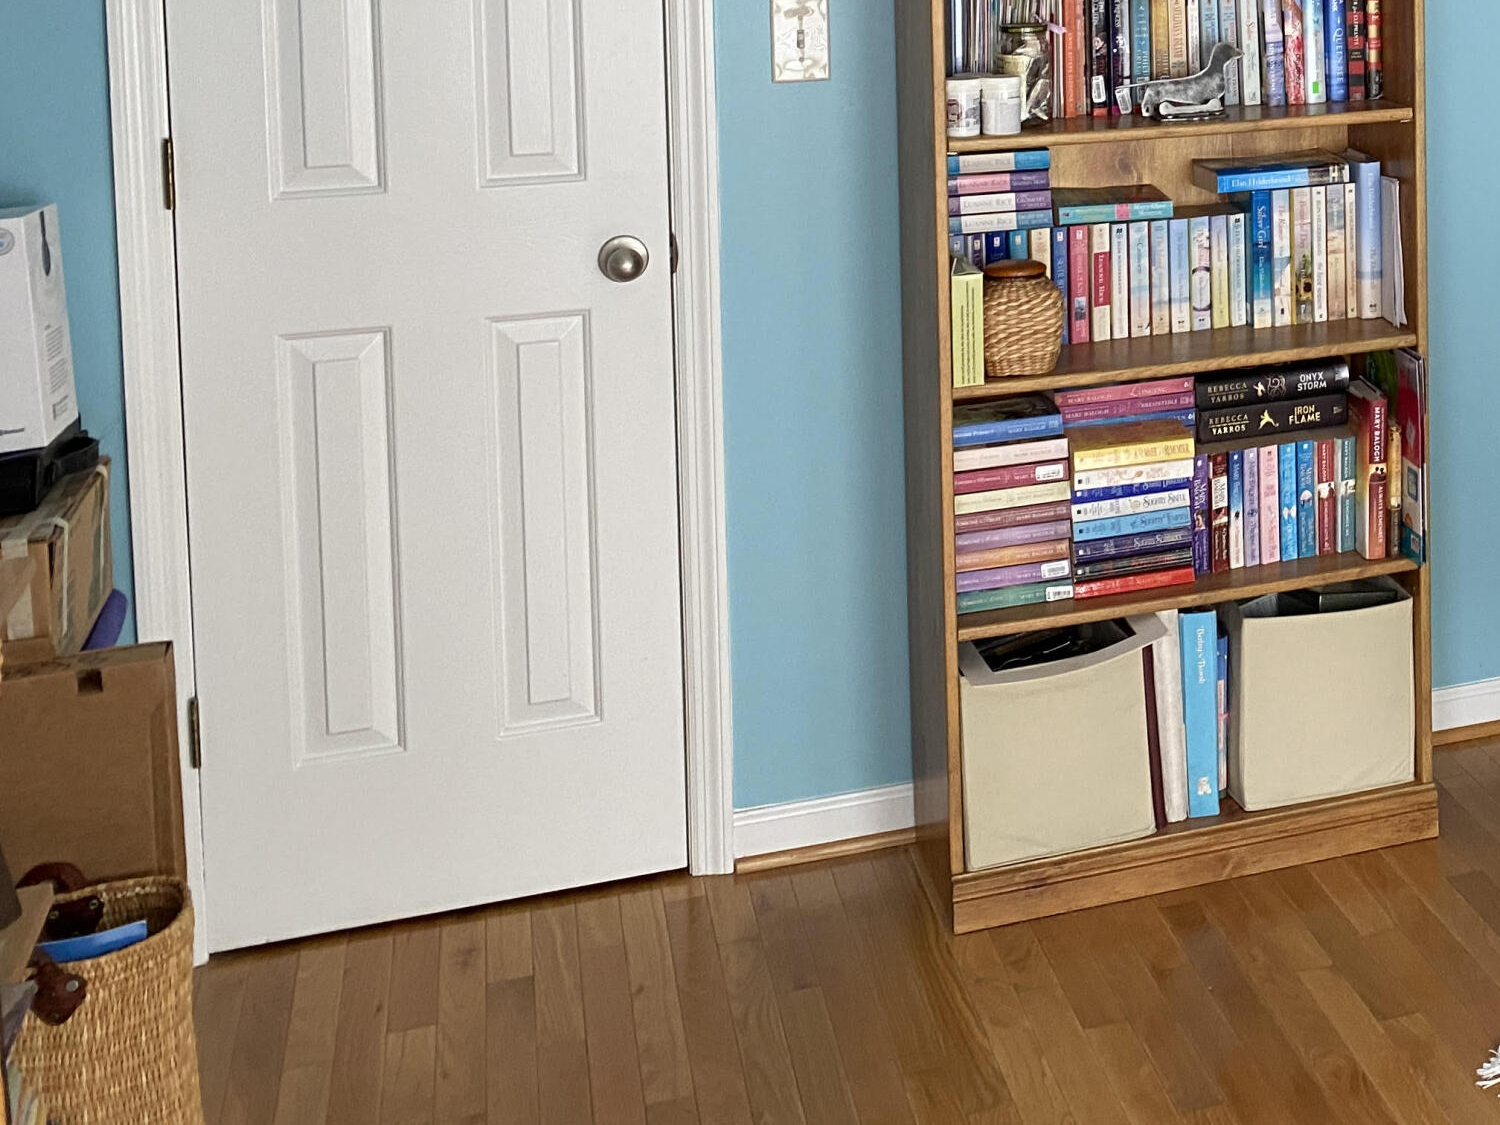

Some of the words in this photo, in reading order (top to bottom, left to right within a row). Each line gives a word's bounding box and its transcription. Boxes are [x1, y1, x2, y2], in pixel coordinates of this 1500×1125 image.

[1333, 27, 1344, 63] QUEEN
[1256, 205, 1267, 229] Silver
[1256, 230, 1268, 249] Girl
[1098, 254, 1107, 284] LUANNE
[1297, 380, 1328, 392] STORM
[1299, 371, 1324, 383] ONYX
[1207, 383, 1248, 394] REBECCA
[1210, 393, 1246, 405] YARROS
[1288, 412, 1322, 426] FLAME
[1294, 404, 1316, 416] IRON
[1373, 406, 1382, 429] MARY
[1208, 414, 1249, 426] REBECCA
[1211, 425, 1247, 436] YARROS
[1373, 430, 1381, 463] BALOGH
[1193, 479, 1202, 510] BALOGH
[1200, 483, 1208, 505] MARY
[1376, 510, 1384, 543] REMEMBER
